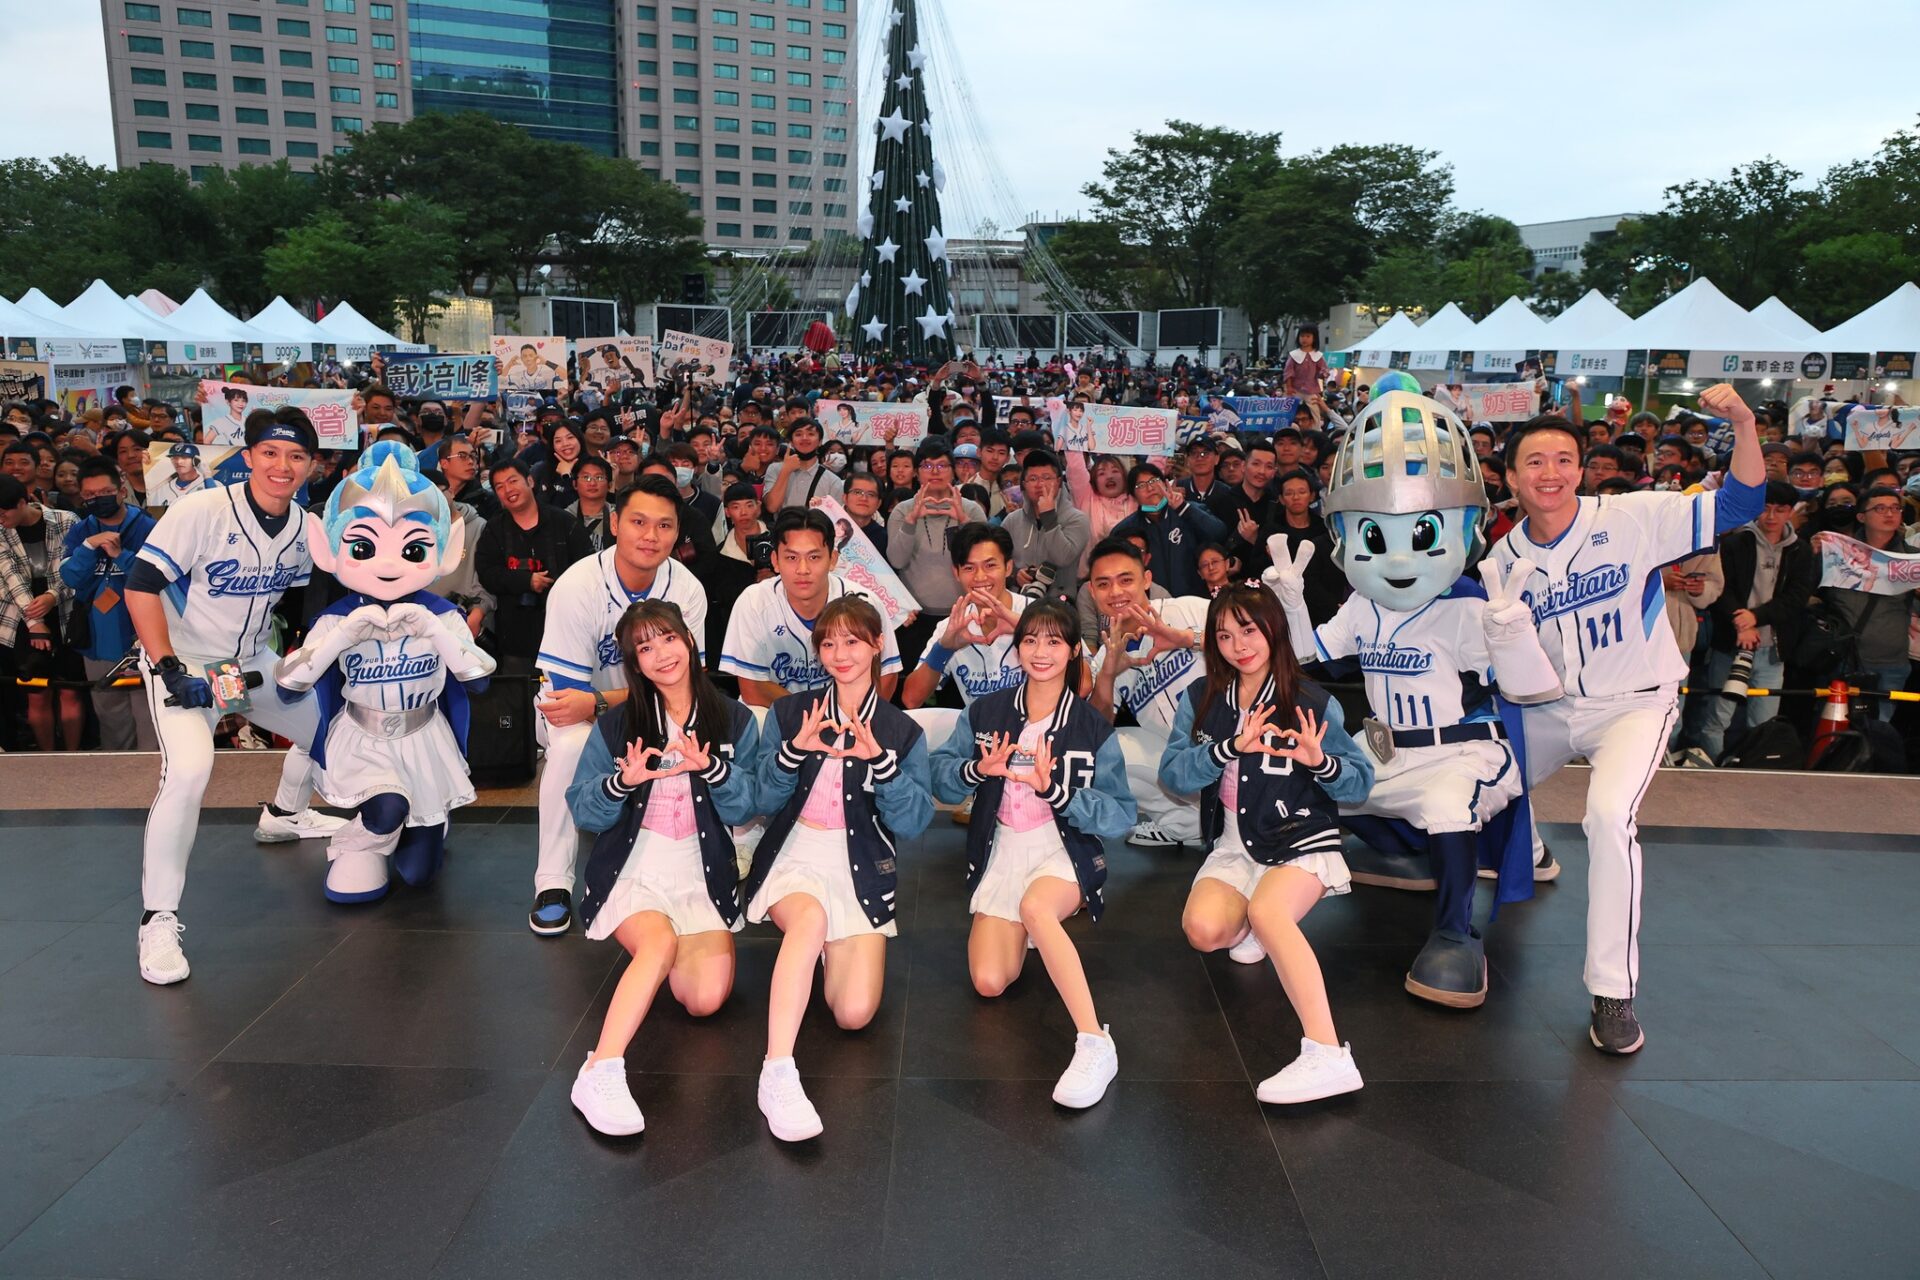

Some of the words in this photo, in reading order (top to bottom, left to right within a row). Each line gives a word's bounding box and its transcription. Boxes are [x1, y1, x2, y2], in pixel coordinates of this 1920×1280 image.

[636, 345, 650, 353] Fan
[386, 359, 489, 397] 戴培峰
[1742, 360, 1796, 373] 富邦金控
[1236, 397, 1295, 413] Travis
[1108, 415, 1168, 447] 奶昔
[345, 653, 440, 687] Guardians
[364, 656, 397, 664] FUBON
[1394, 692, 1434, 727] 111
